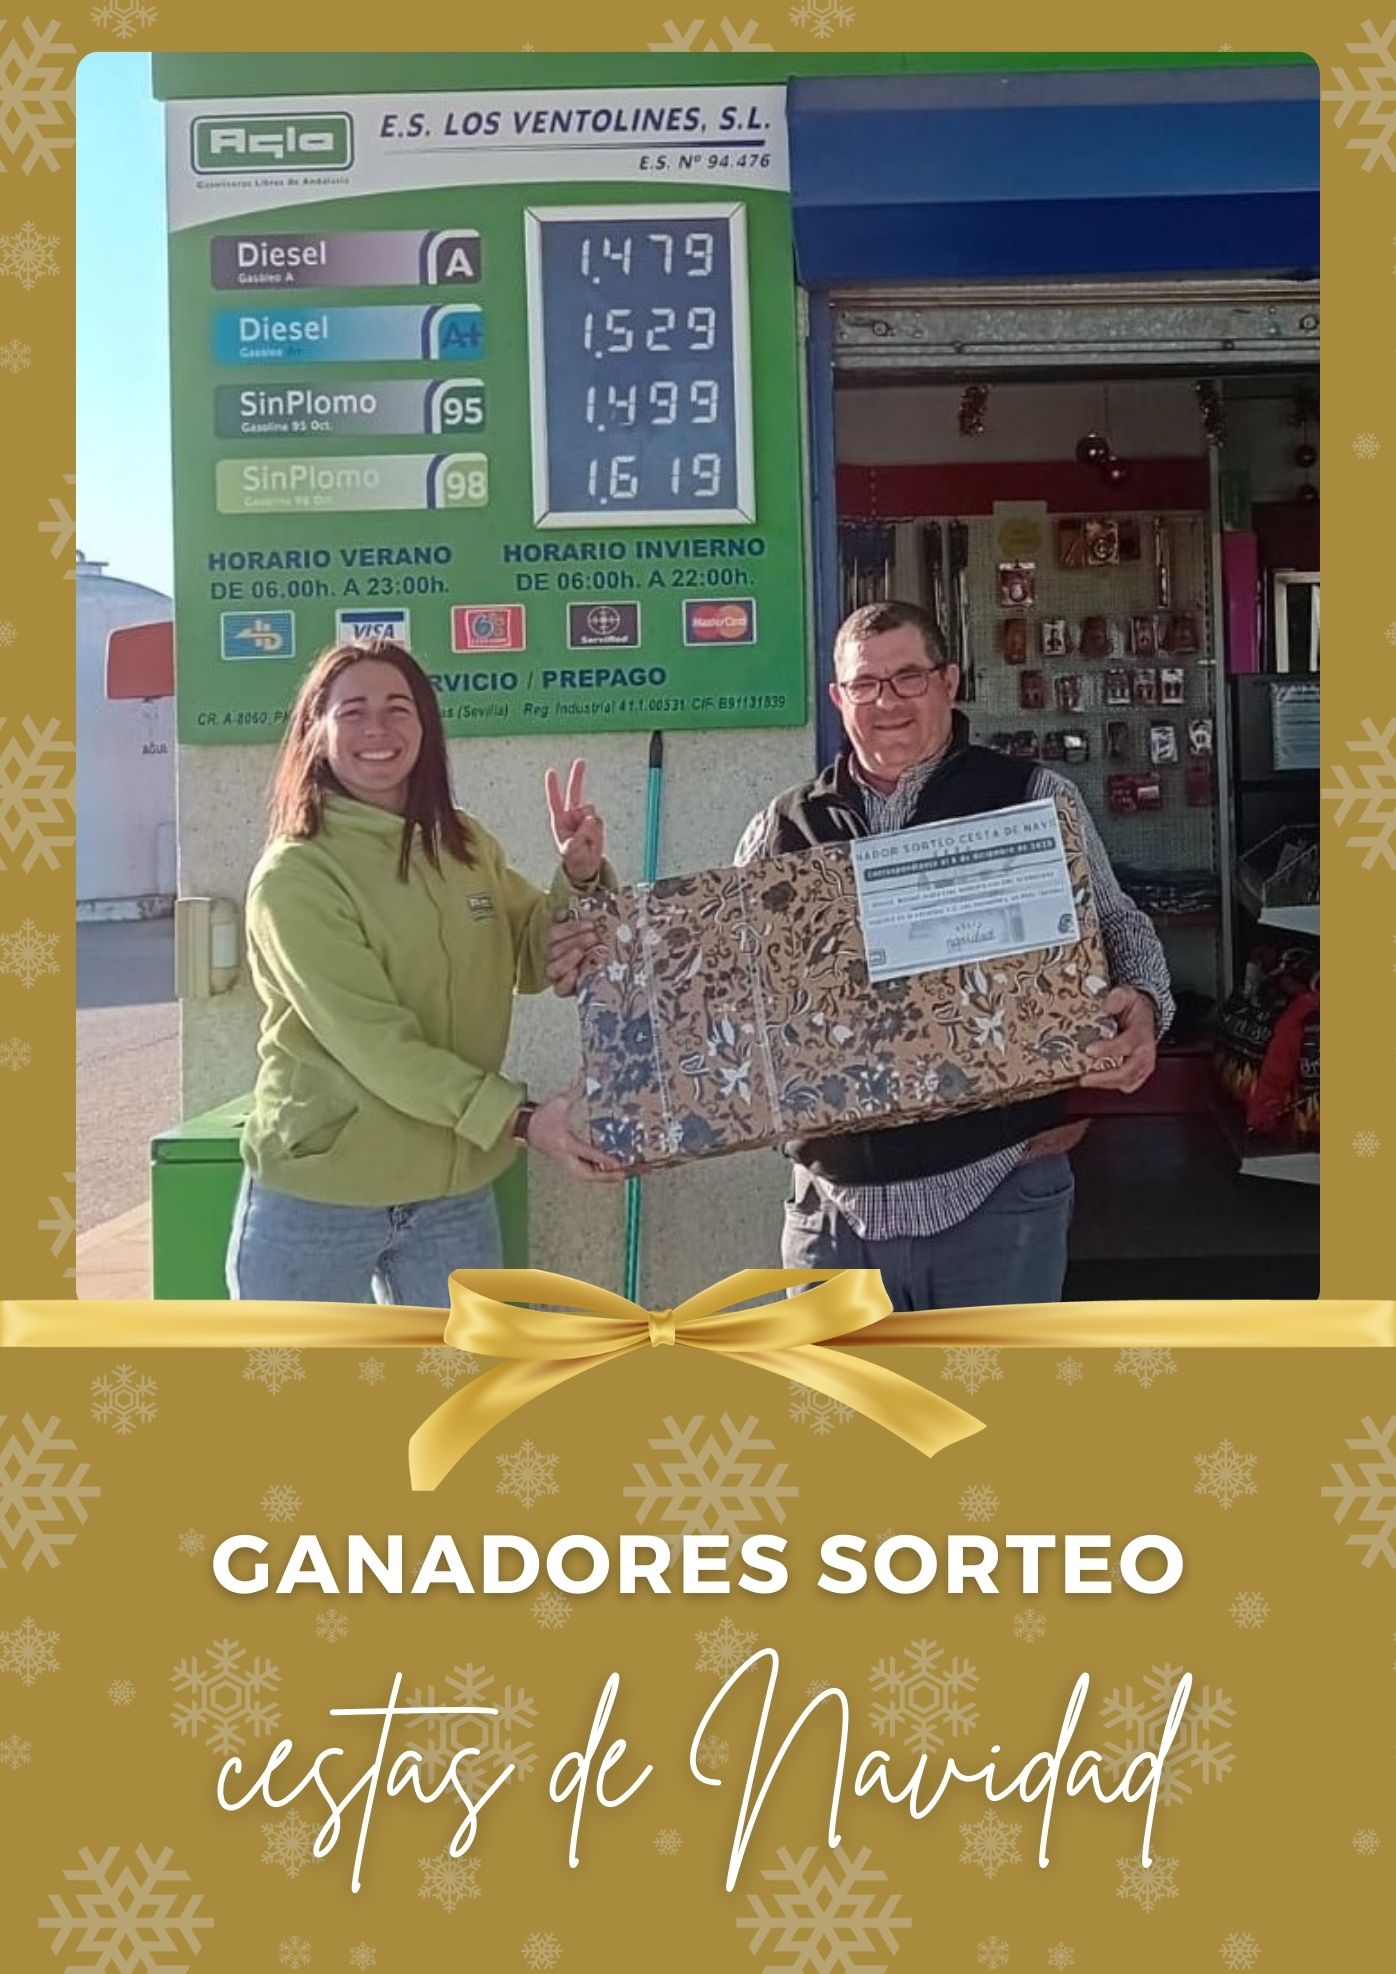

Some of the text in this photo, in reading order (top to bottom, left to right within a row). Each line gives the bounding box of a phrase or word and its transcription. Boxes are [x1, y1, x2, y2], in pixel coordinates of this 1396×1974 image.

[380, 105, 771, 138] E.S. LOS VENTOLINES, S.L.
[639, 153, 772, 171] E.S. Nº 94.476
[238, 240, 475, 278] Diesel A
[581, 233, 714, 285] 1.479
[285, 271, 295, 282] A
[239, 315, 482, 348] Diesel A+
[584, 307, 716, 359] 1.529
[240, 390, 484, 425] SinPlomo 95
[586, 380, 719, 432] 1.499
[241, 421, 289, 434] Gasolina
[291, 420, 308, 432] 95
[243, 464, 487, 500] SinPlomo 98
[588, 452, 721, 505] 1.619
[208, 546, 453, 572] HORARIO VERANO
[503, 537, 766, 563] HORARIO INVIERNO
[211, 581, 243, 600] DE
[343, 578, 360, 597] A
[366, 575, 450, 597] 23:00h.
[516, 567, 755, 591] DE 06:00h. A 22:00h.
[354, 623, 396, 640] VISA
[542, 666, 667, 690] PREPAGO
